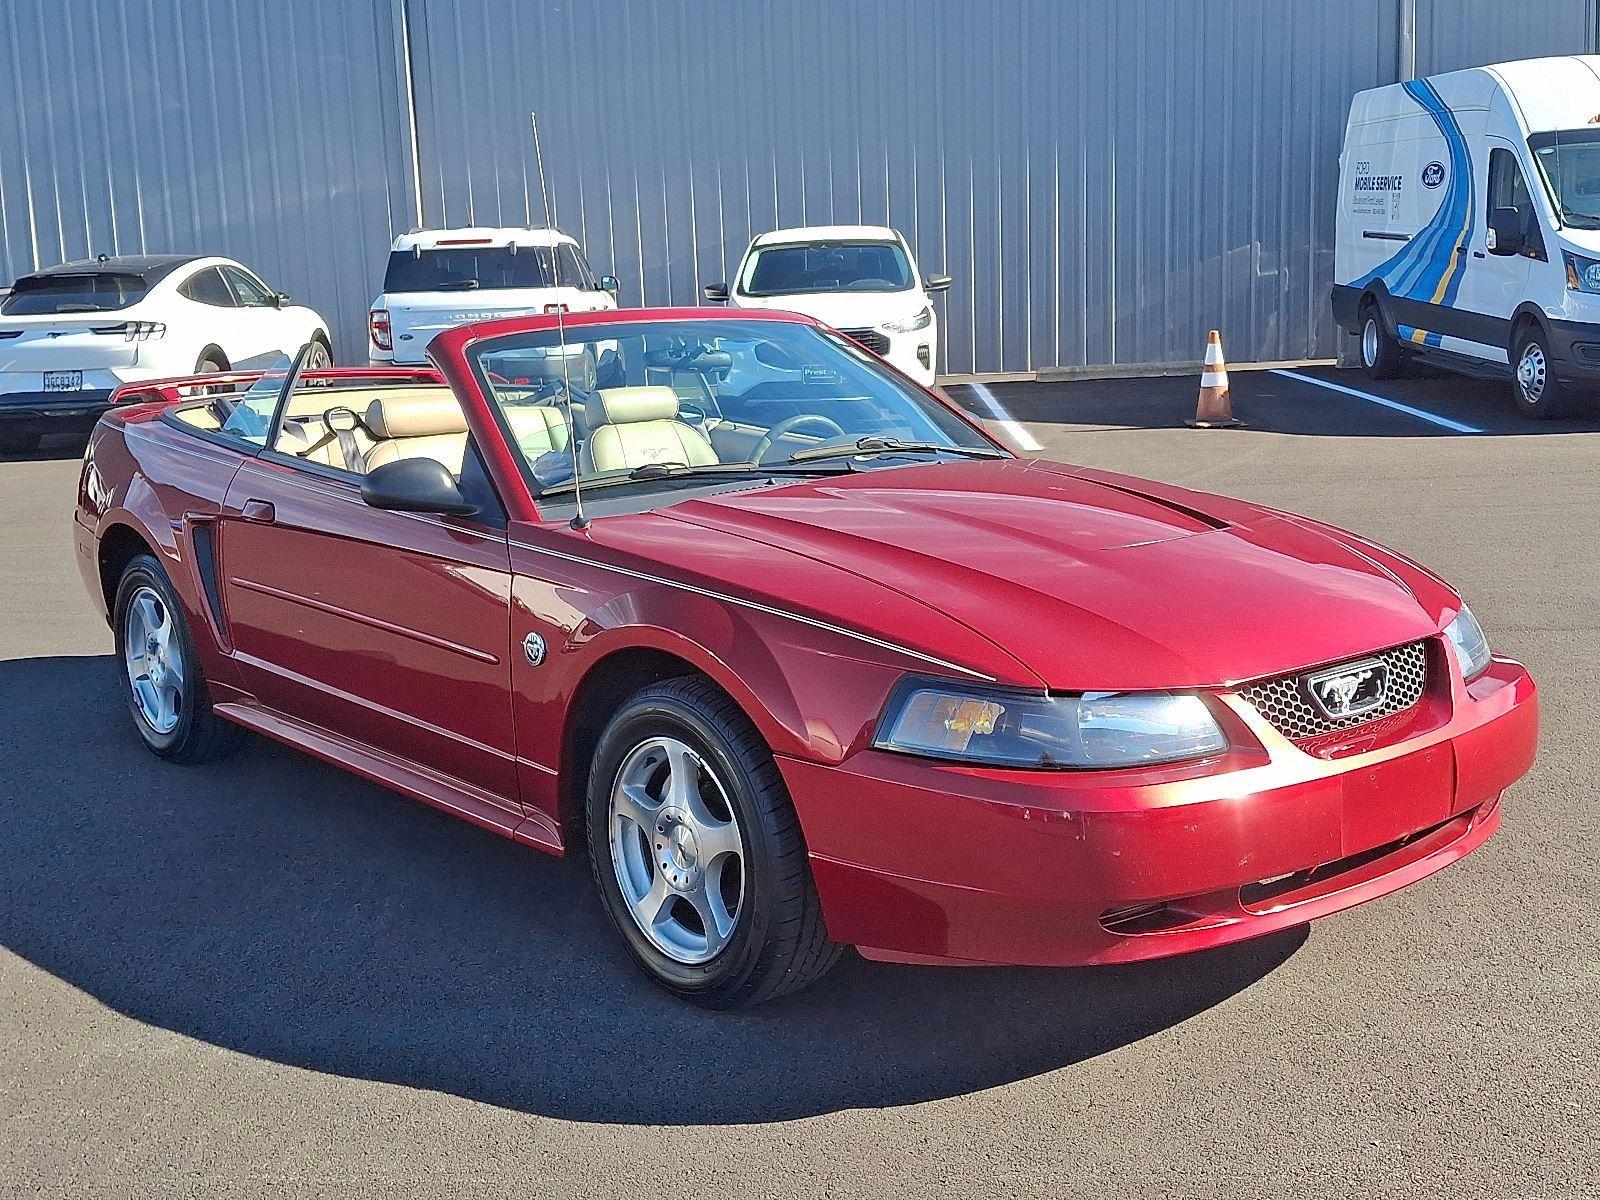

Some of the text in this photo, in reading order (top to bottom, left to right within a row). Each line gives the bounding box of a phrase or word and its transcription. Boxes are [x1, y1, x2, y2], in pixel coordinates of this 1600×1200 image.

[1424, 165, 1443, 184] Ford
[1355, 176, 1403, 191] MOBILE SERVICE
